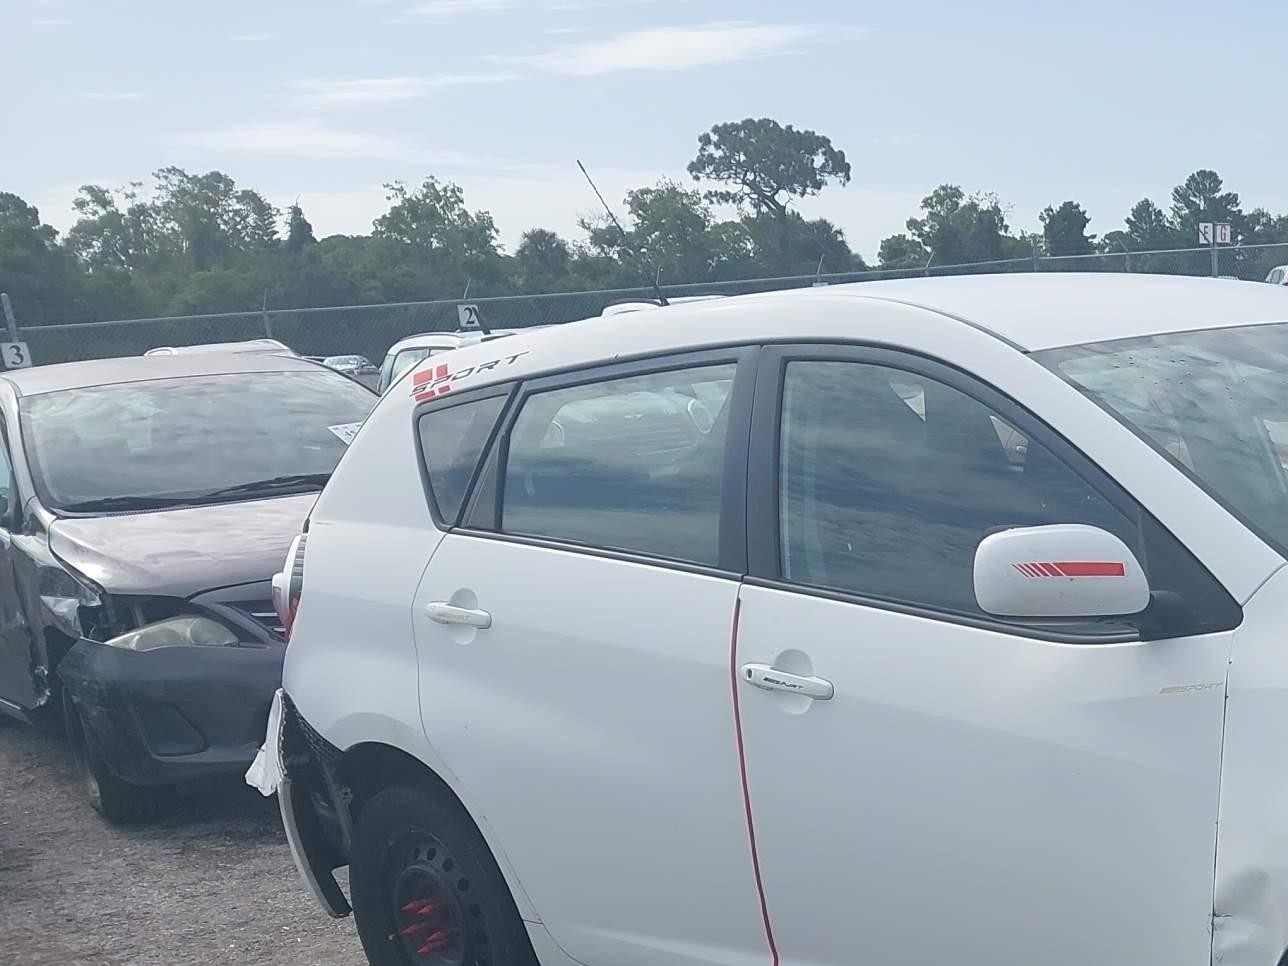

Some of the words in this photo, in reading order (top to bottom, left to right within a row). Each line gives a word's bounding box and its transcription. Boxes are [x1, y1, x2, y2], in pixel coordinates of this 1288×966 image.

[1221, 225, 1227, 241] G
[463, 307, 475, 325] 2
[9, 345, 24, 366] 3
[409, 351, 529, 397] SPORT
